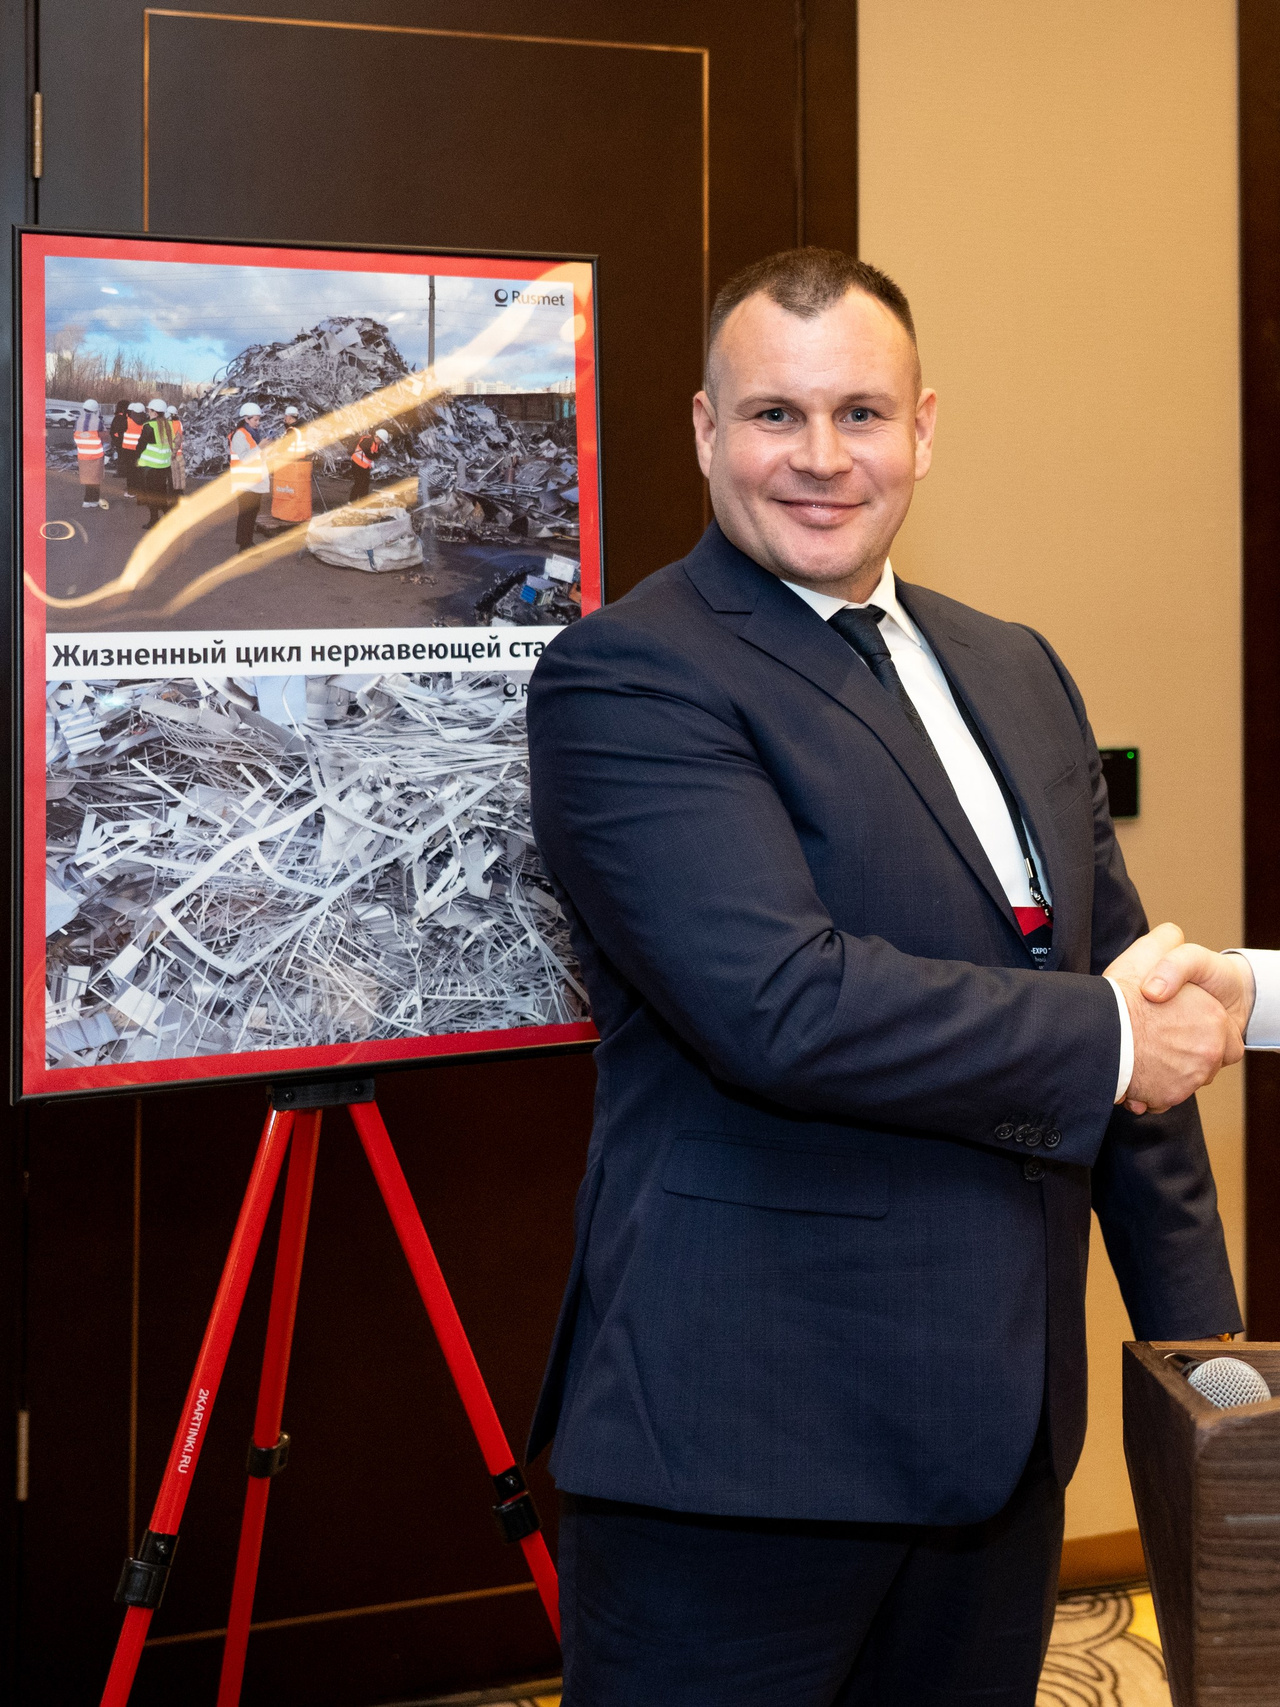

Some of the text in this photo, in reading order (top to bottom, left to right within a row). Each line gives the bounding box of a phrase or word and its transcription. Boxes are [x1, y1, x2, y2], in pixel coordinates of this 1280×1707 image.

[512, 290, 565, 306] Rusmet
[52, 635, 546, 668] Жизненный цикл нержавеющей ста
[1030, 947, 1048, 955] -EXPO
[177, 1388, 210, 1474] 2KARTINKI.RU
